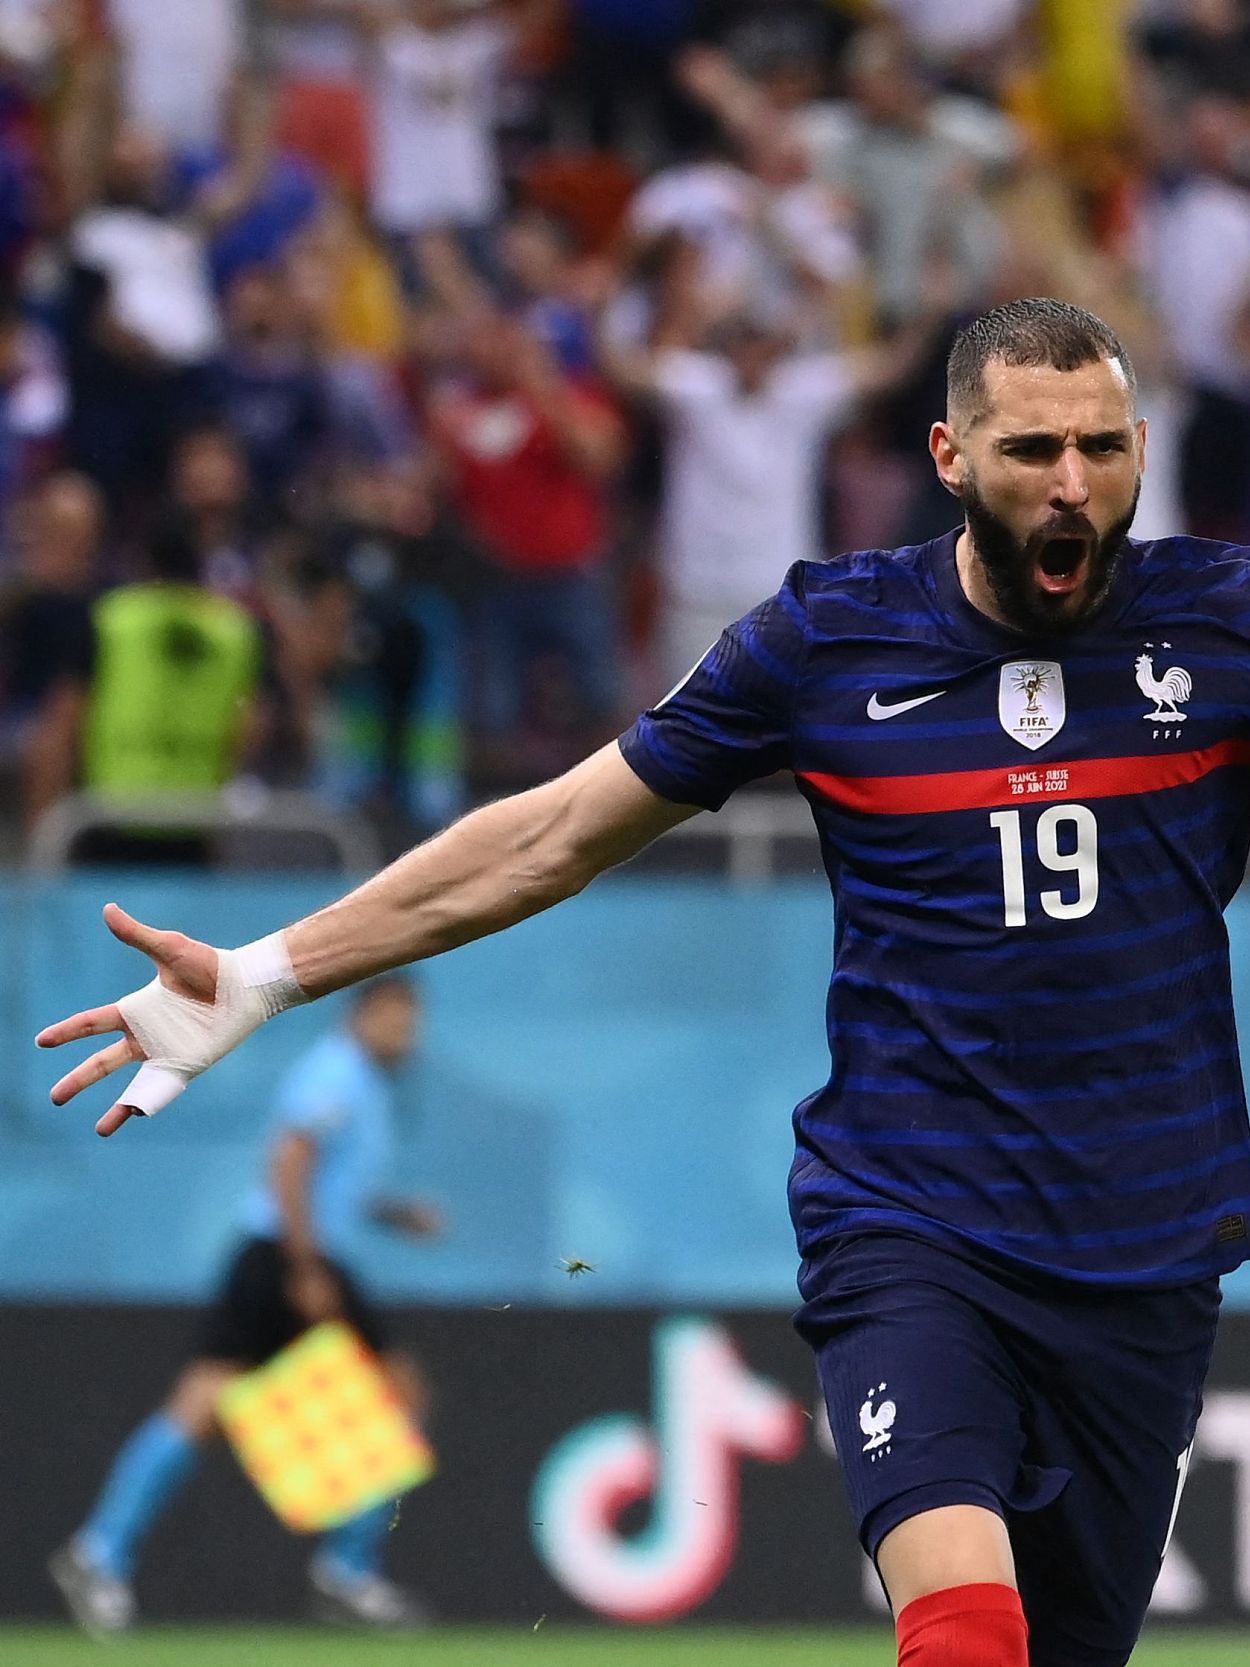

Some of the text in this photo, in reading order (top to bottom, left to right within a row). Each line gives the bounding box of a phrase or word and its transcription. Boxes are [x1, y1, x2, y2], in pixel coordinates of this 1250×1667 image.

[1019, 717, 1047, 727] FIFA
[1008, 772, 1037, 784] FRANCE
[1046, 769, 1069, 780] SUISSE
[1012, 783, 1024, 794] 28
[1045, 780, 1067, 791] 2021
[990, 804, 1098, 927] 19
